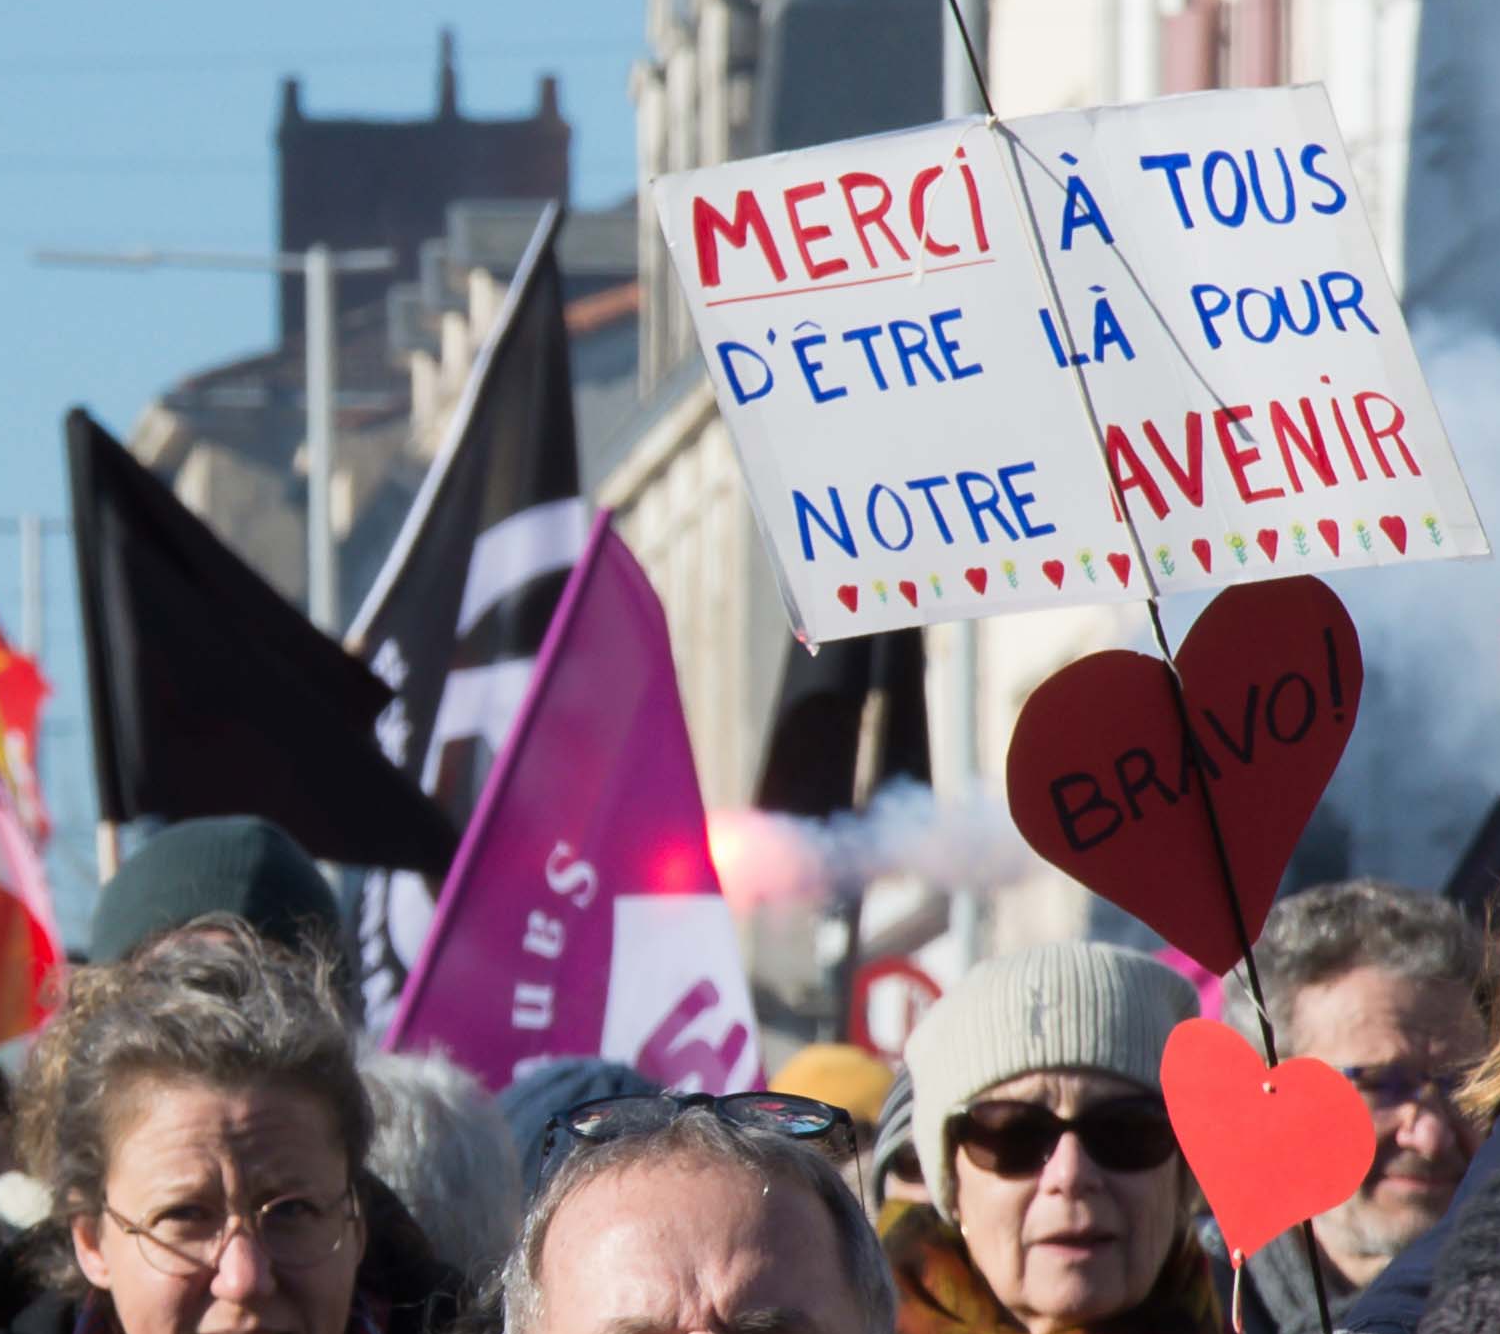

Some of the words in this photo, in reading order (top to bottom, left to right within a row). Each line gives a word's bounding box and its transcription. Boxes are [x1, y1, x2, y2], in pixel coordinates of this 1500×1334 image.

[1060, 153, 1114, 251] À
[1140, 143, 1348, 231] TOUS
[716, 307, 984, 406] D'ÊTRE
[1040, 284, 1136, 368] LÀ
[1190, 271, 1380, 351] POUR
[792, 461, 1056, 563] NOTRE
